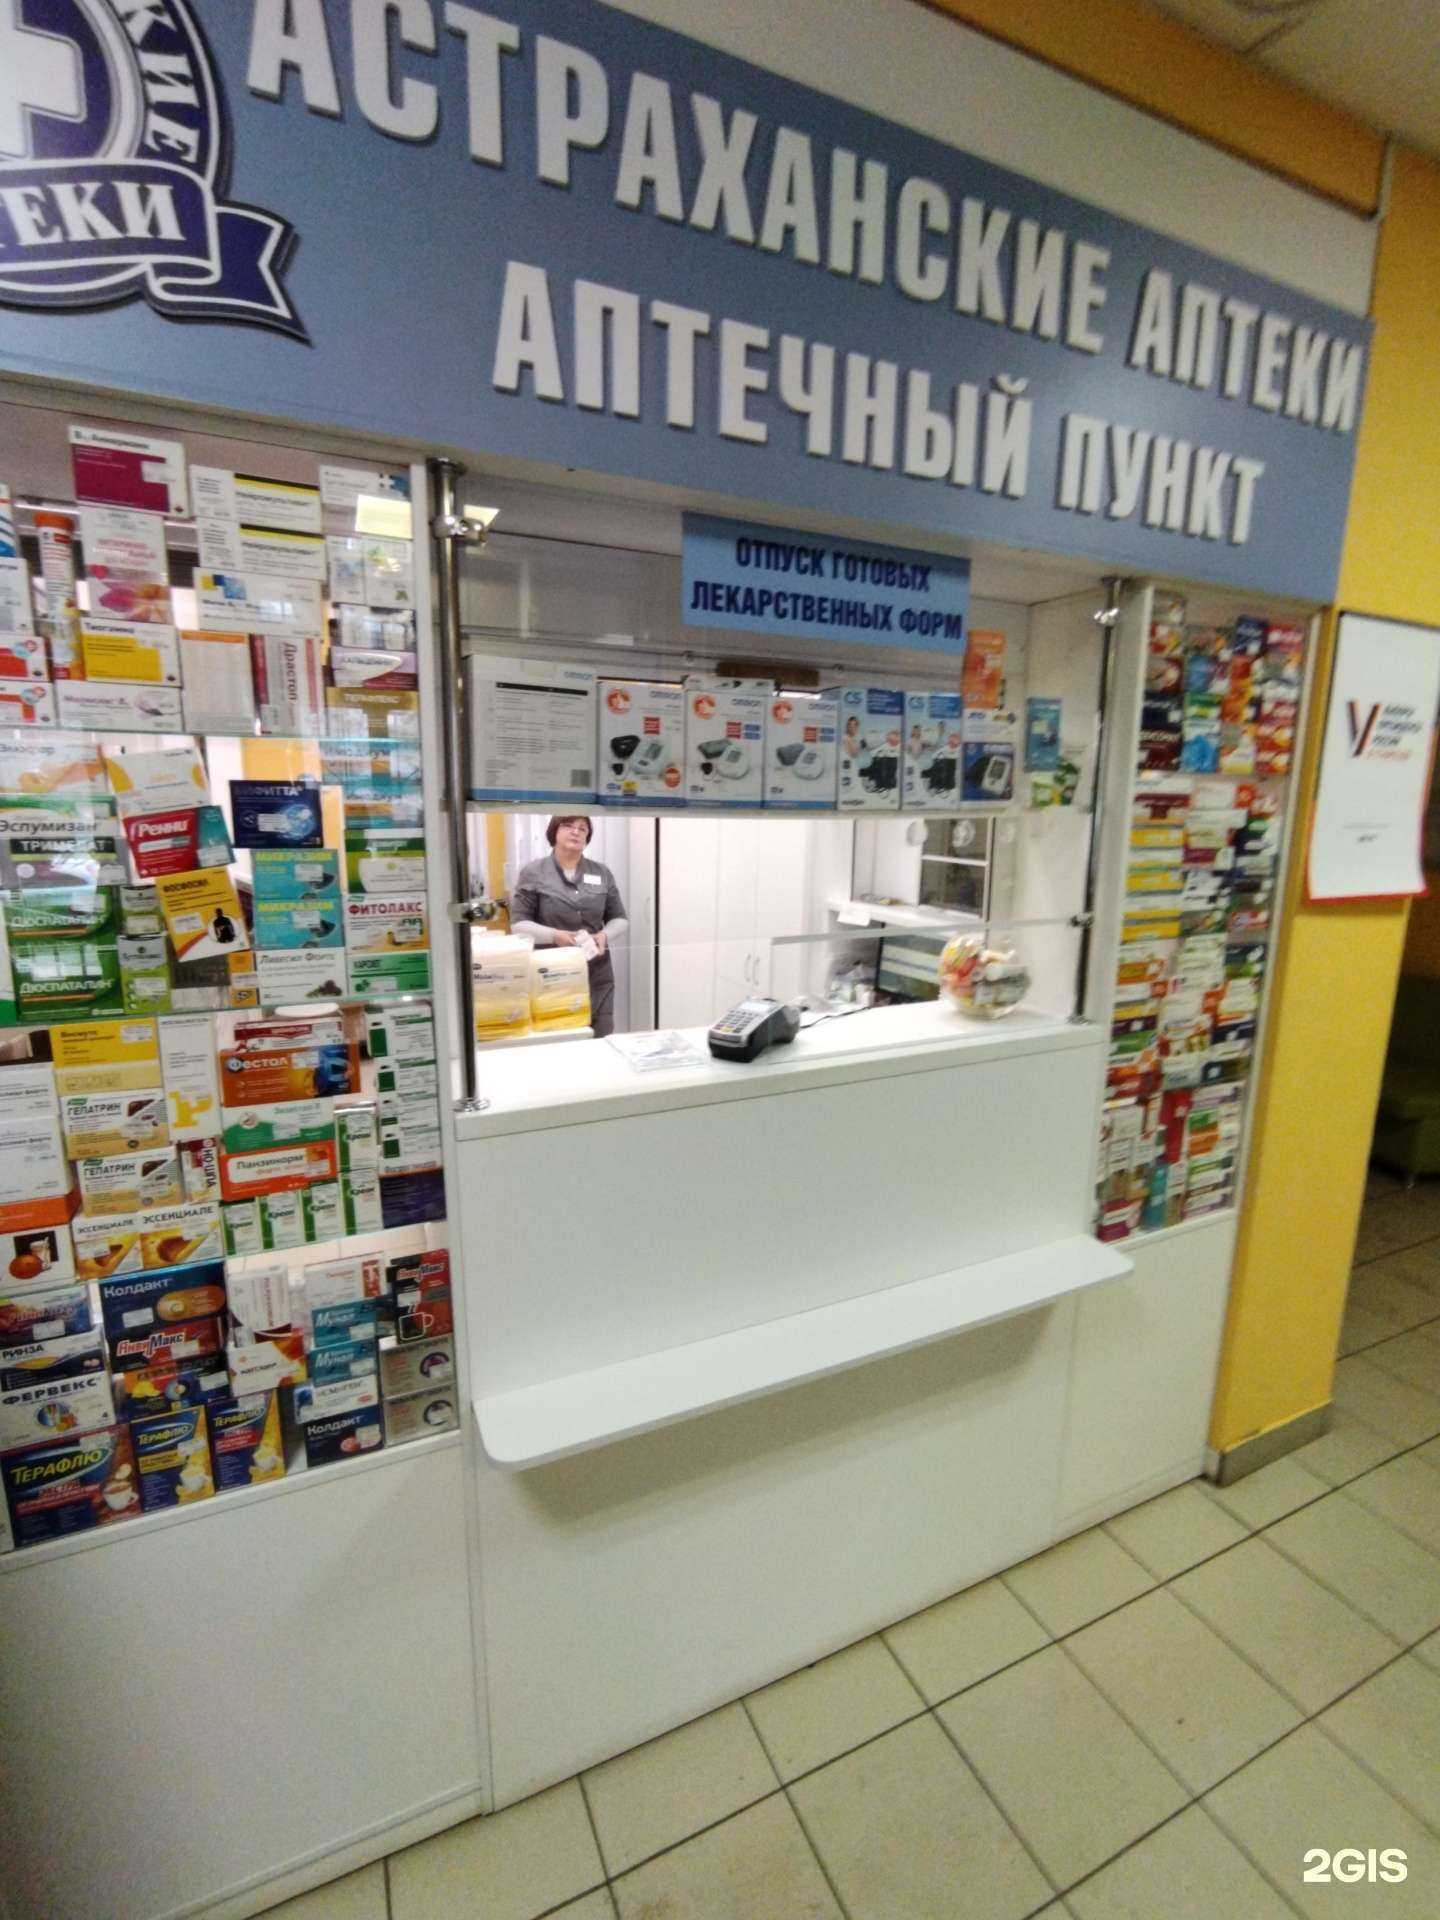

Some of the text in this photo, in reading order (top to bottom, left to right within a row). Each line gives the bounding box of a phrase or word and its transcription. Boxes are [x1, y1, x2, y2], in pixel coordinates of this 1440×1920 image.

[0, 181, 187, 248] ЕКИ
[246, 0, 1365, 431] АСТРАХАНСКИЕ АПТЕКИ
[493, 260, 1266, 546] АПТЕЧНЫЙ ПУНКТ
[735, 536, 933, 593] ОТПУСК ГОТОВЫХ
[691, 580, 963, 640] ЛЕКАРСТВЕННЫХ ФОРМ
[138, 820, 188, 837] Ренни
[348, 902, 422, 915] ФИТОЛАКС
[227, 1056, 288, 1072] Фестал
[67, 1102, 121, 1116] ГЕПАТРИН
[84, 1163, 136, 1177] ГЕПАТРИН
[143, 1205, 214, 1224] ЭССЕНЦИАЛЕ
[104, 1278, 169, 1299] Колдакт
[116, 1331, 187, 1359] АнвиМакс
[3, 1378, 98, 1405] ФЕРВЕКС
[307, 1415, 361, 1436] Колдакт
